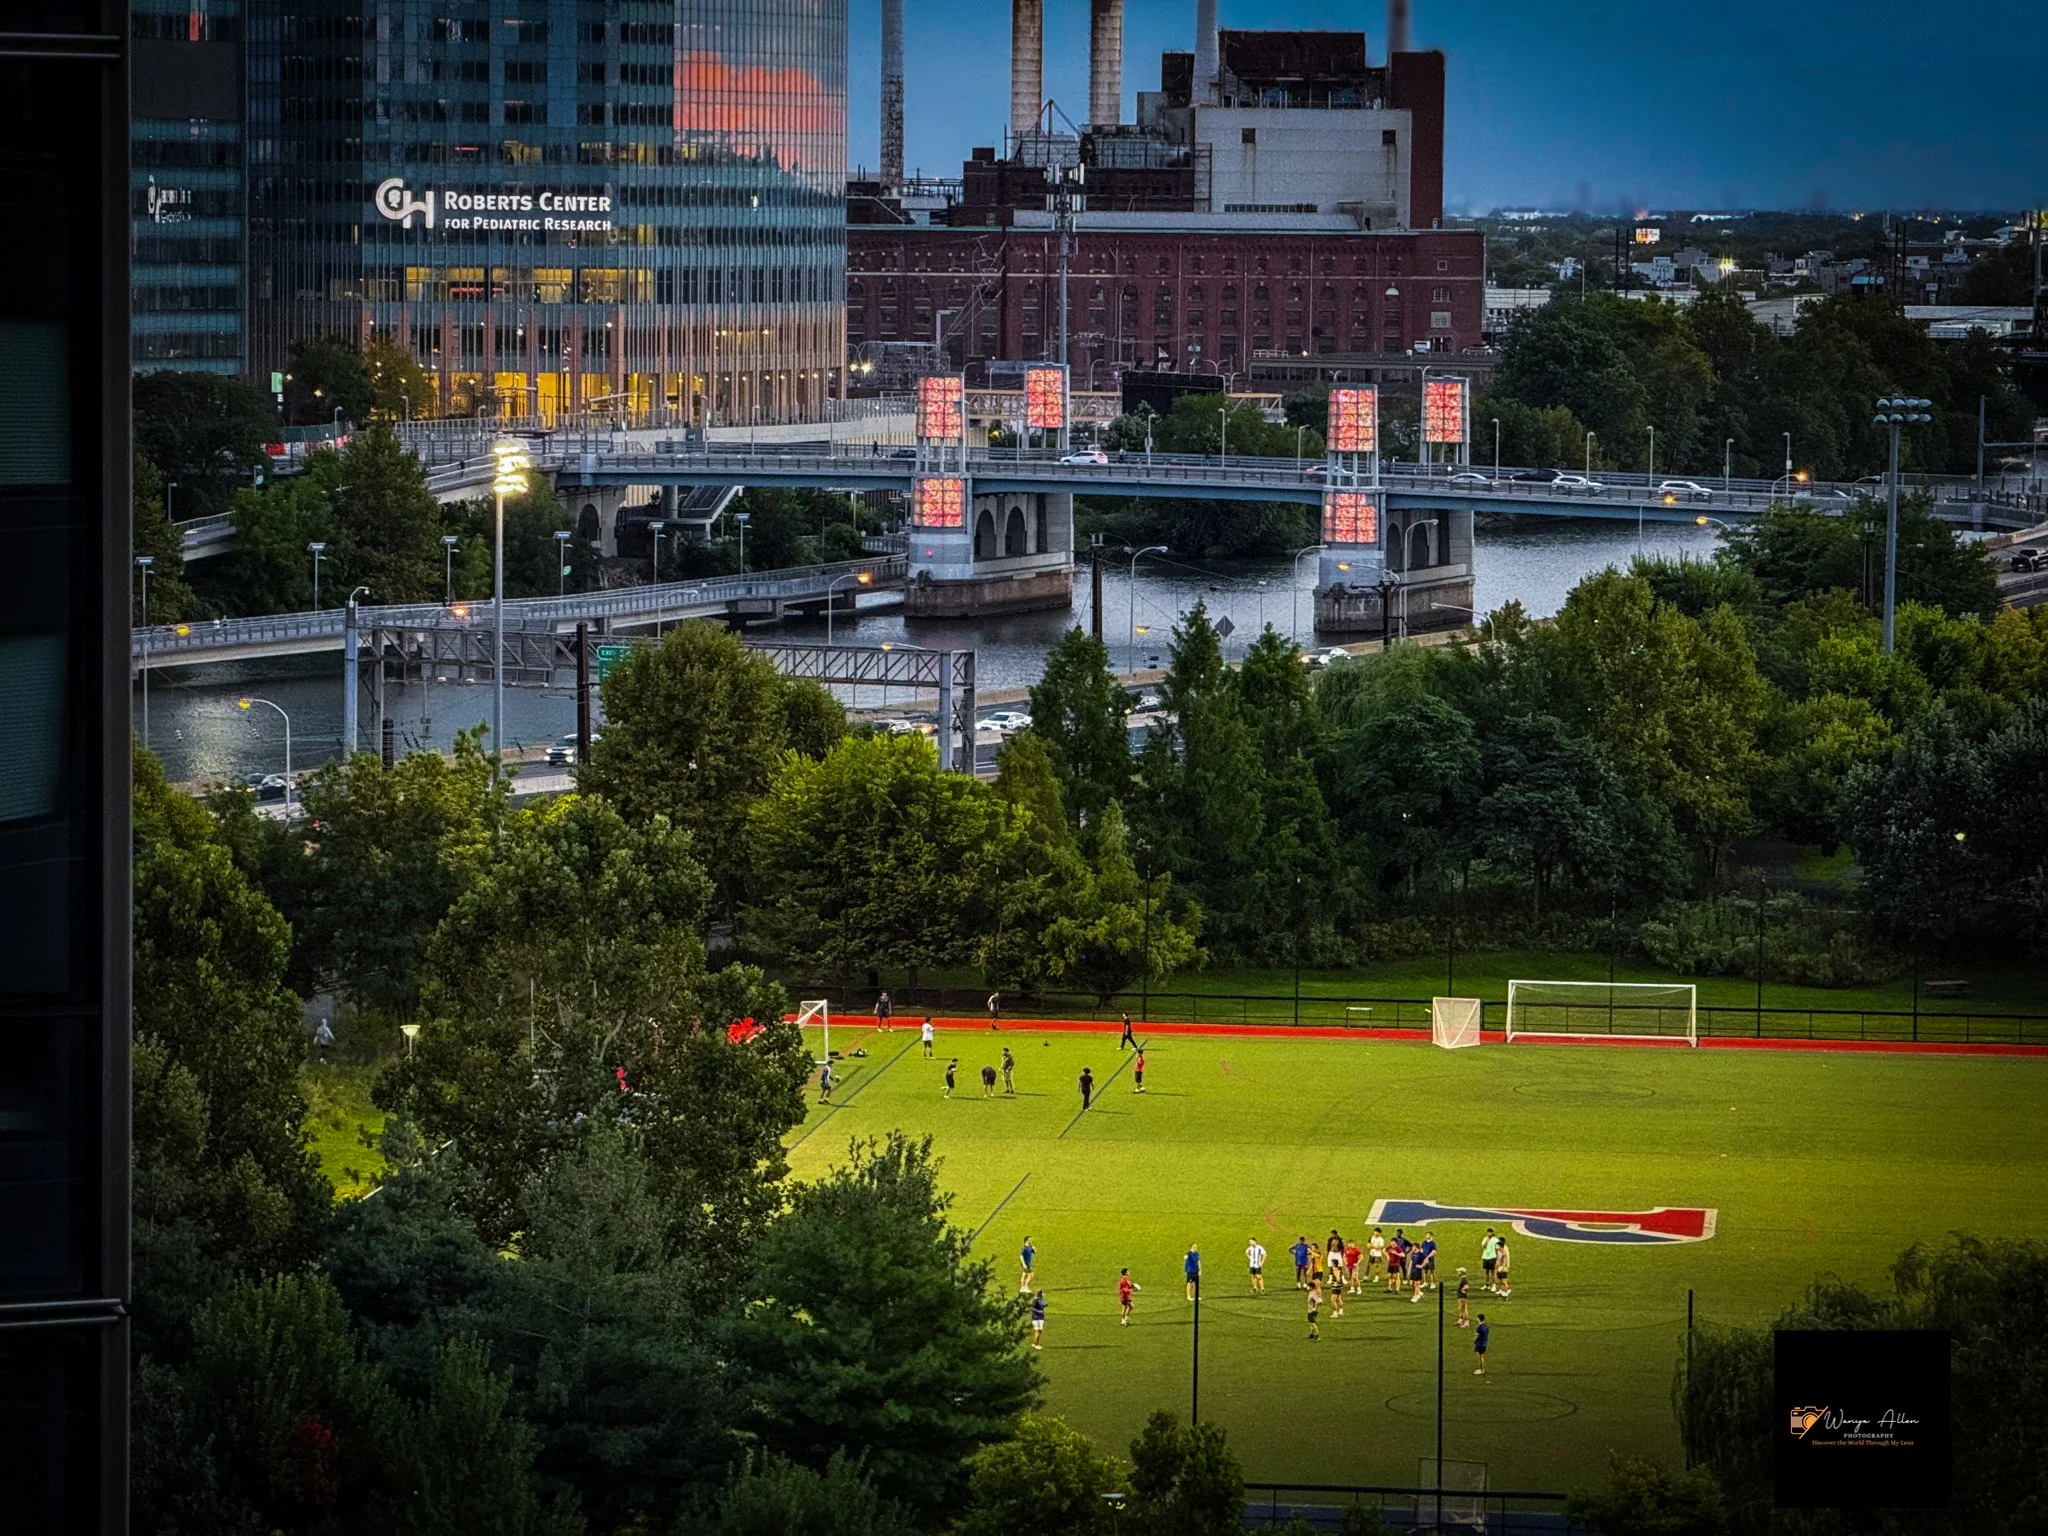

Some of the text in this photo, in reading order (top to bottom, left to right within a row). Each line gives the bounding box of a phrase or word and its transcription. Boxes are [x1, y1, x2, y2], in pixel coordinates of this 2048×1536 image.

[445, 191, 611, 212] ROBERTS CENTER
[473, 217, 540, 230] PEDIATRIC
[544, 217, 611, 231] RESEARCH
